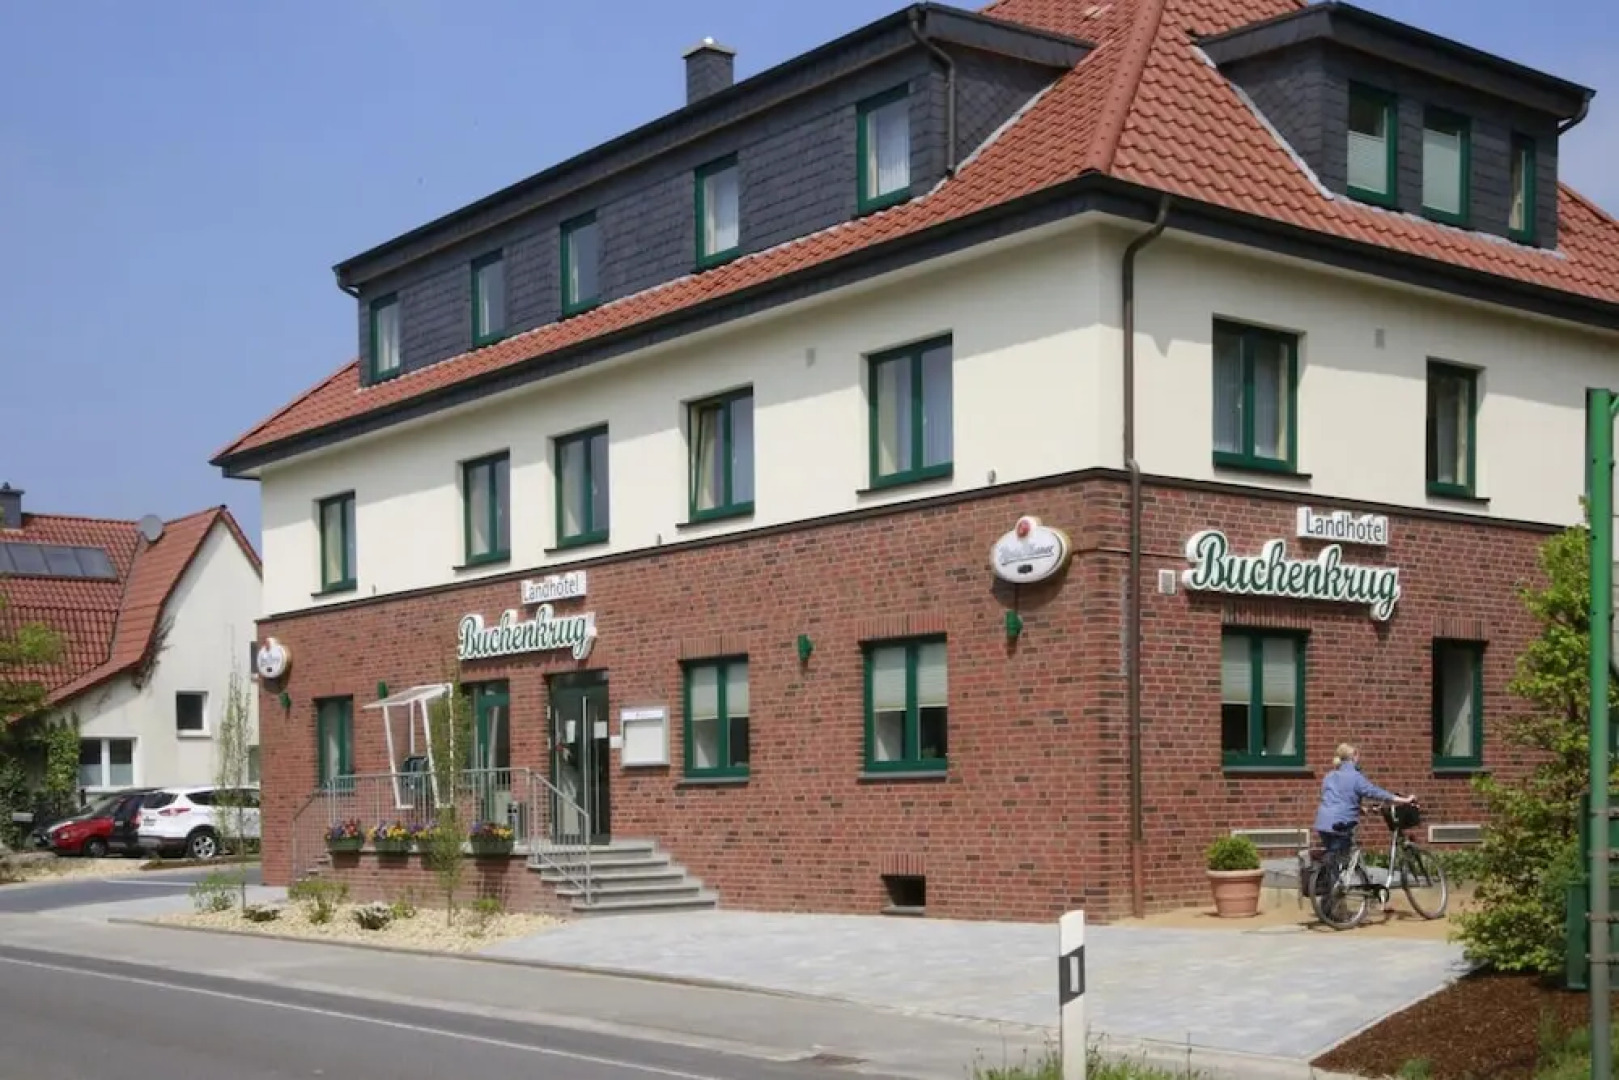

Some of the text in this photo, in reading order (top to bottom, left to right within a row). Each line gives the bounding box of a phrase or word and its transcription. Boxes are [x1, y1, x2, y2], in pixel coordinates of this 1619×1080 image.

[1306, 509, 1387, 544] Landhotel
[1191, 532, 1397, 618] Buchenkrug
[459, 606, 586, 655] Buchenkrug
